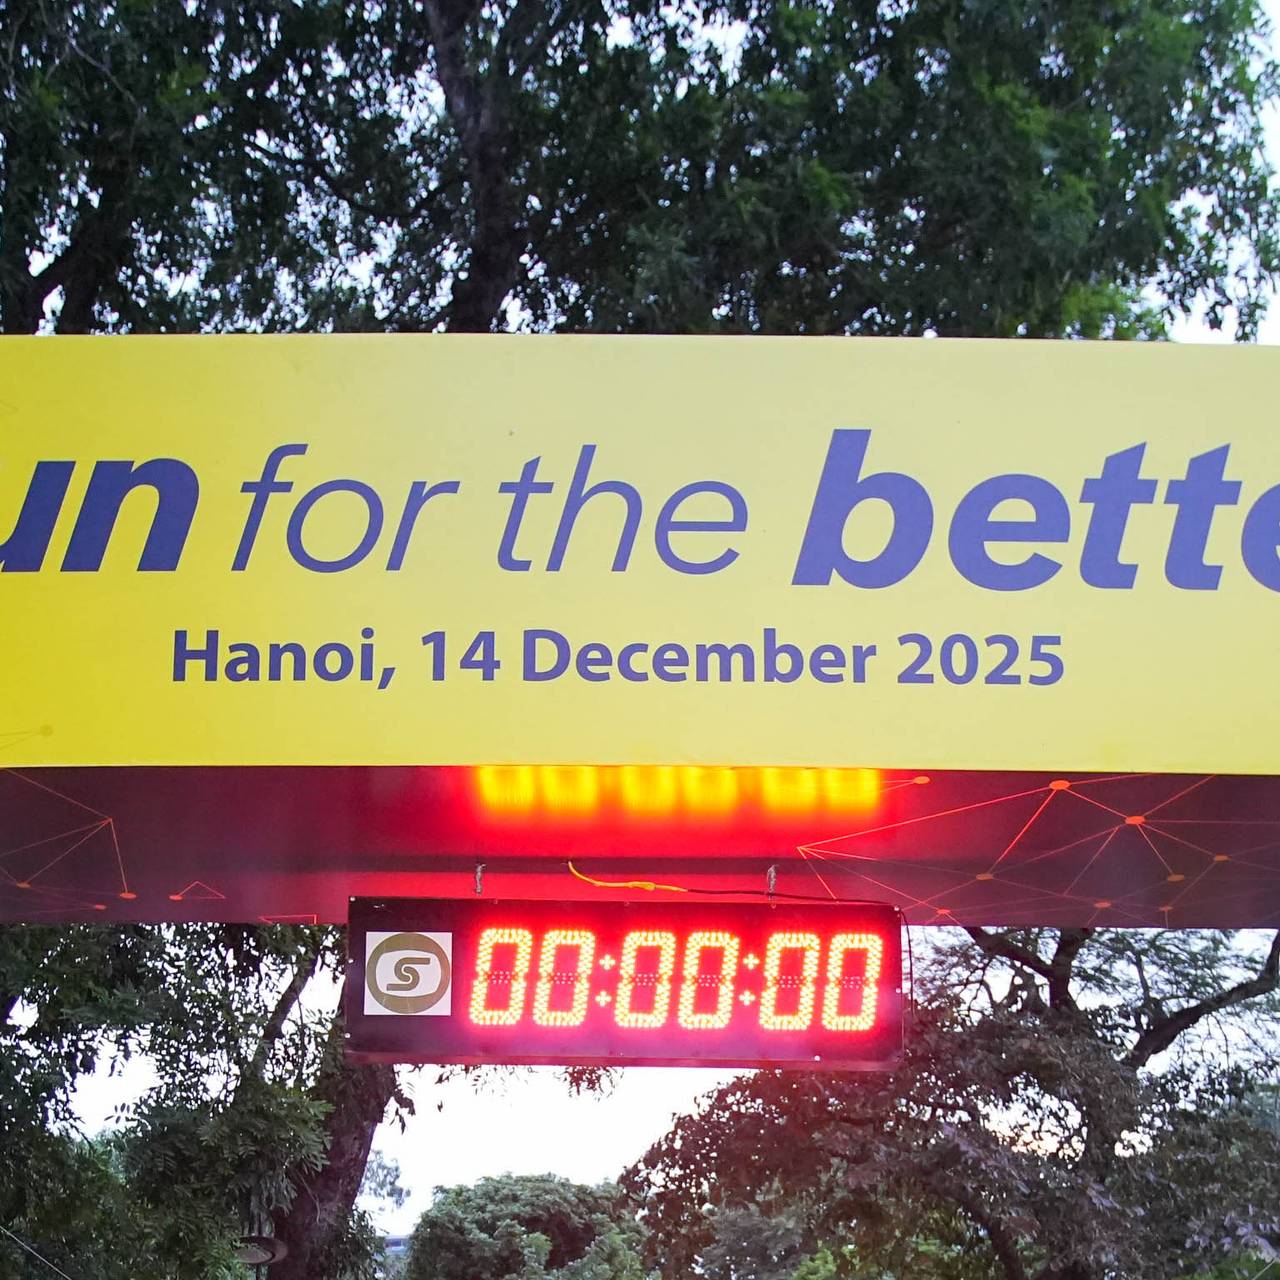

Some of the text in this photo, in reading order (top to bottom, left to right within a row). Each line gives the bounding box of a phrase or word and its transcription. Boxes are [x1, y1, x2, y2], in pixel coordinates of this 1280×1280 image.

[231, 443, 460, 572] for
[496, 445, 748, 575] the
[173, 627, 1065, 690] Hanoi, 14 December 2025
[469, 928, 883, 1031] 00:00:00
